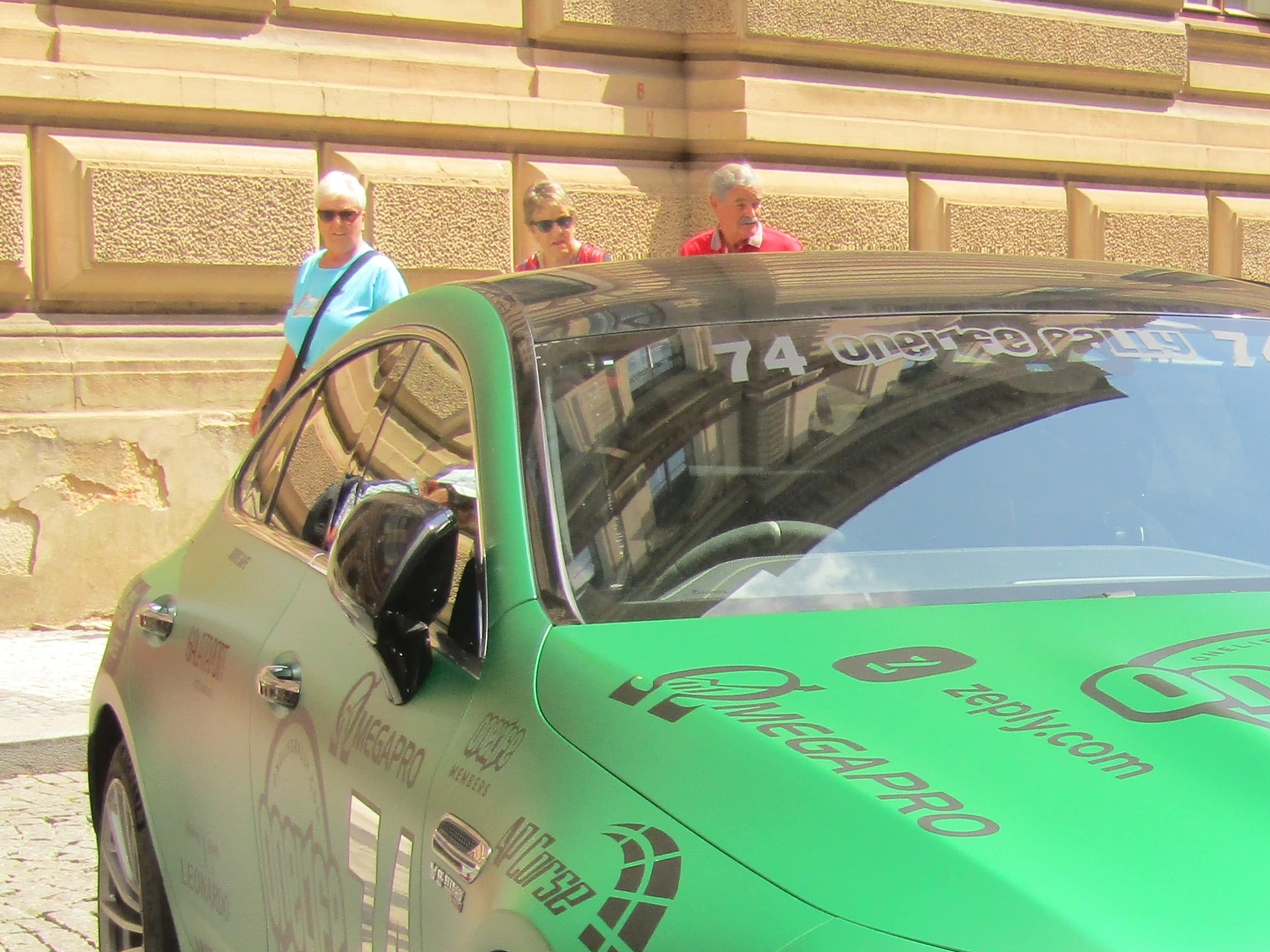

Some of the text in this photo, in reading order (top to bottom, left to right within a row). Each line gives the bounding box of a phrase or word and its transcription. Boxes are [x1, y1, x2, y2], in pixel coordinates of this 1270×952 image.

[712, 335, 807, 382] 74
[943, 683, 1155, 781] zeply.com
[449, 764, 491, 797] MEMBERS
